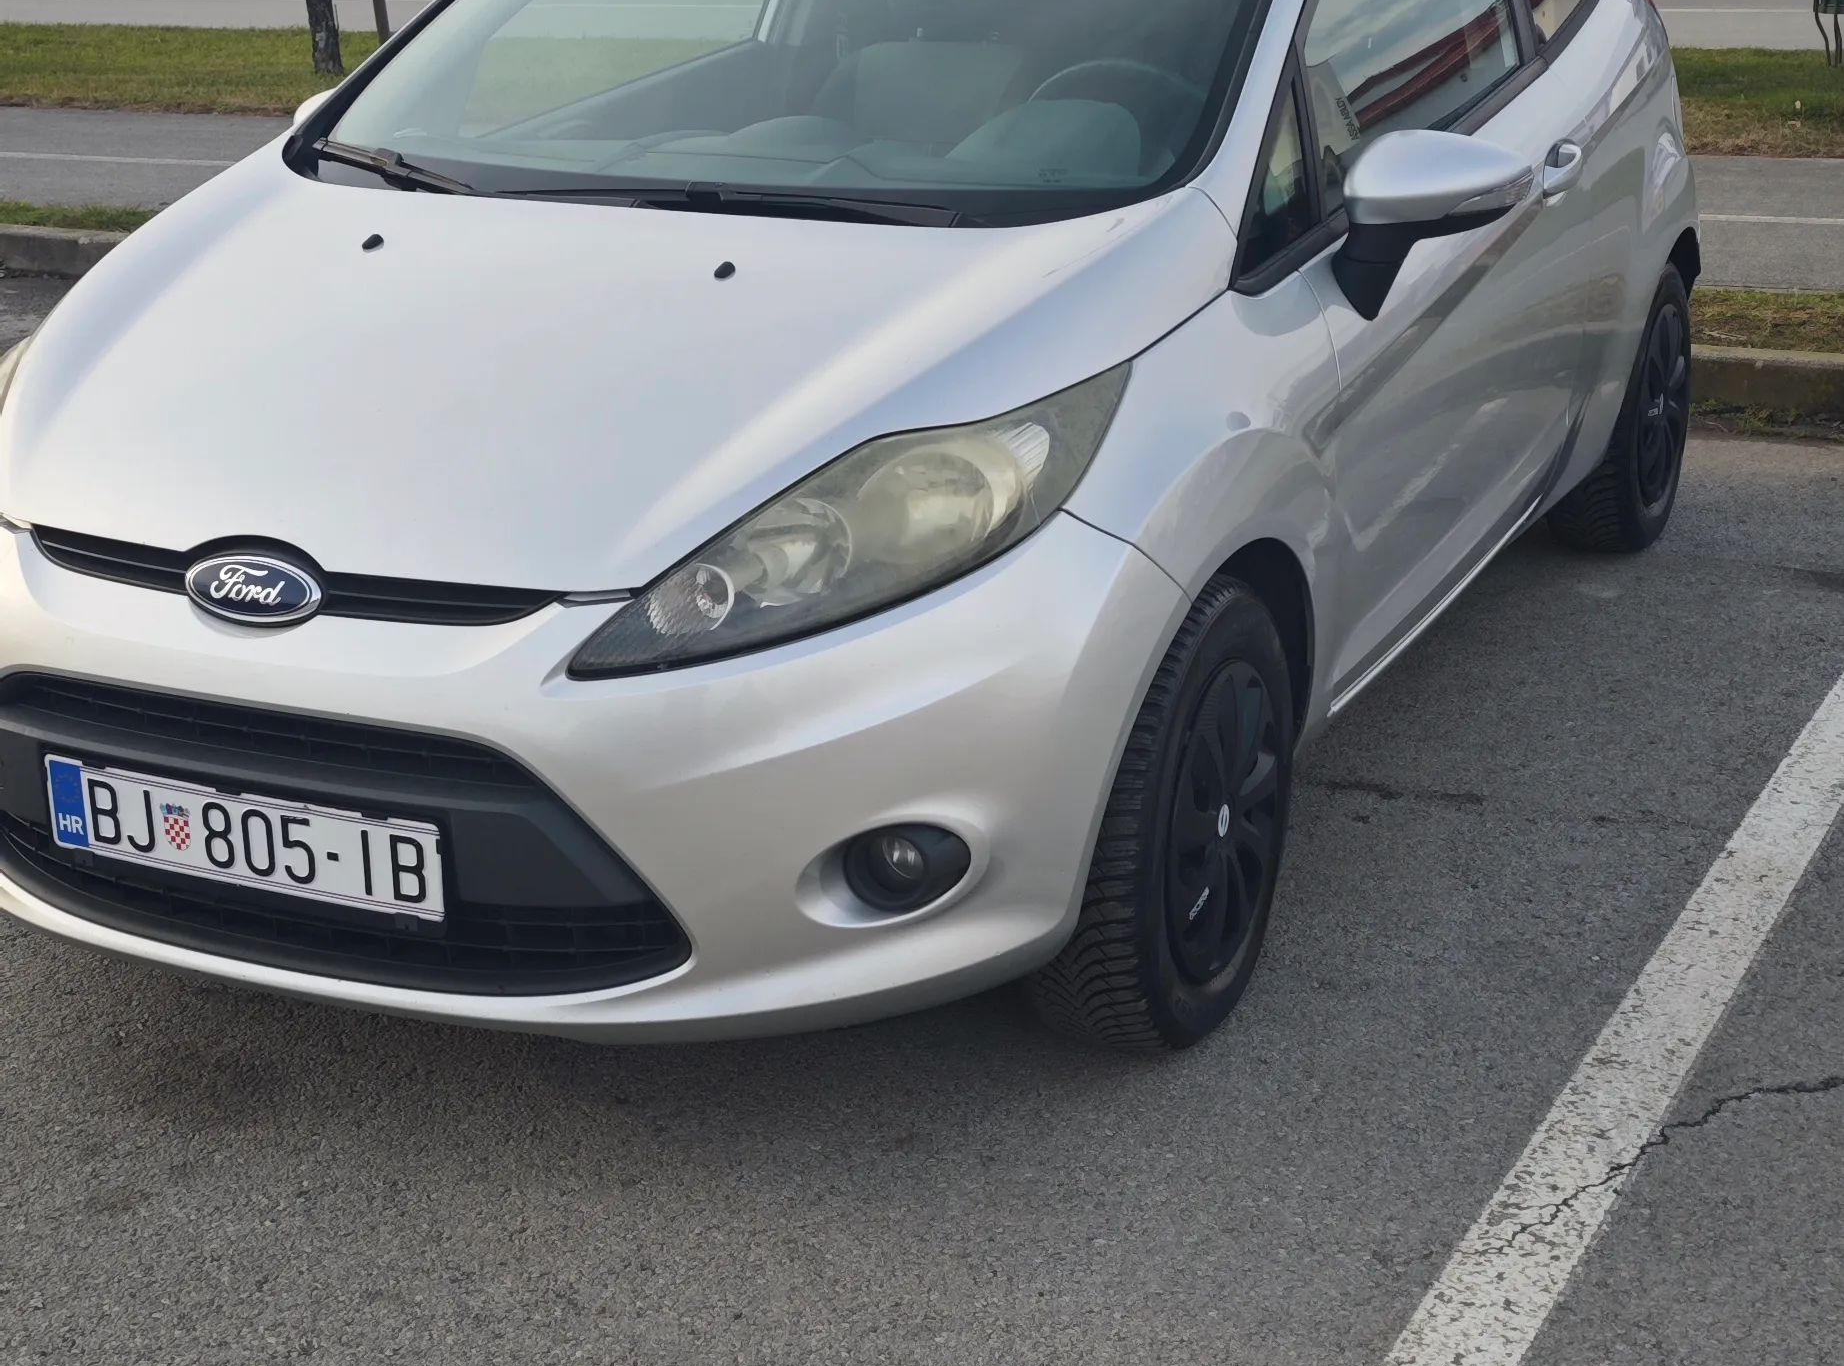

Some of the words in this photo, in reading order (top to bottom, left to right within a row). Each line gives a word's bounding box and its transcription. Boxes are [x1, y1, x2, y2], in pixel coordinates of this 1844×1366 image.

[209, 564, 286, 606] Ford
[59, 812, 85, 836] HR
[87, 778, 156, 853] BJ
[201, 801, 427, 903] 805-IB
